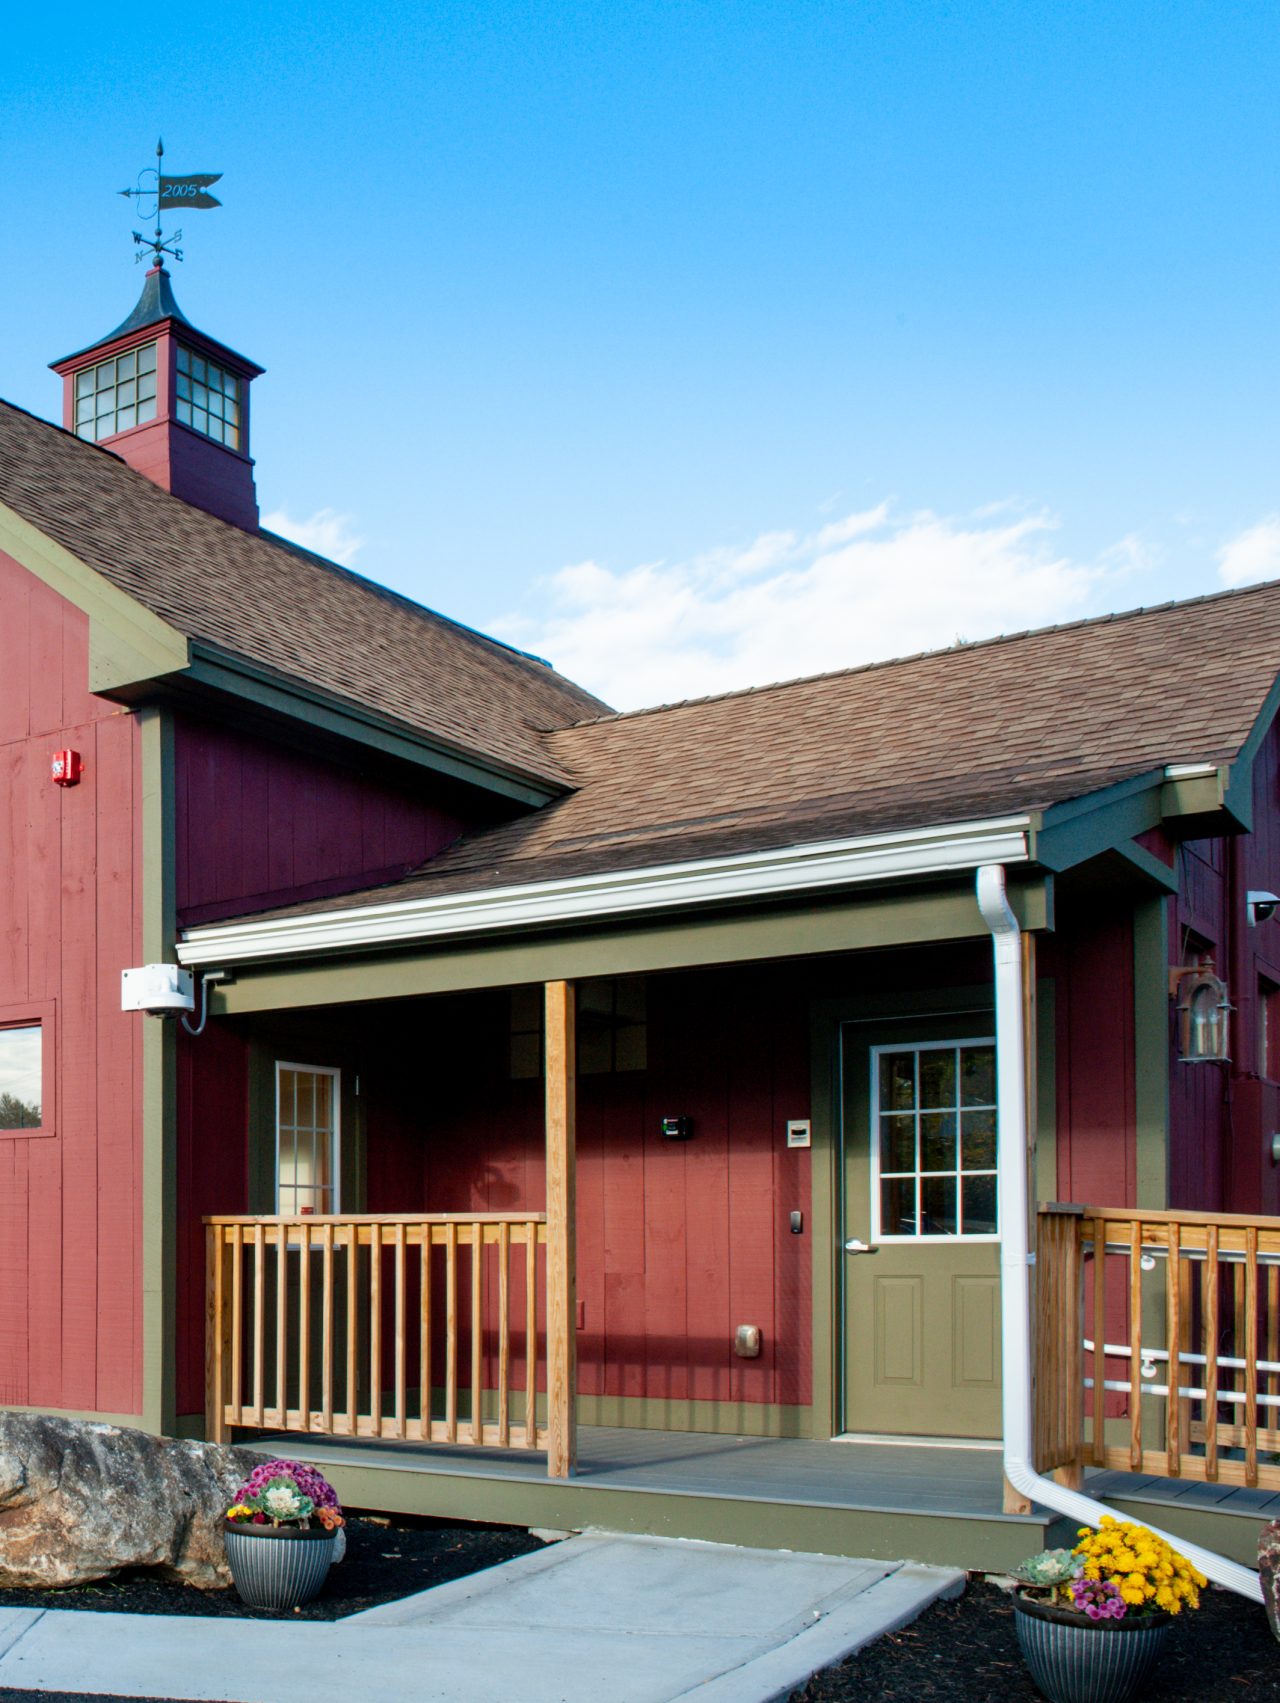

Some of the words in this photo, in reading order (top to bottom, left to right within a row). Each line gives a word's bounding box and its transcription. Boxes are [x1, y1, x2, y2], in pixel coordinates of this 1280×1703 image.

[161, 184, 197, 198] 2005
[132, 230, 142, 244] W
[135, 250, 143, 264] N
[175, 248, 183, 262] E
